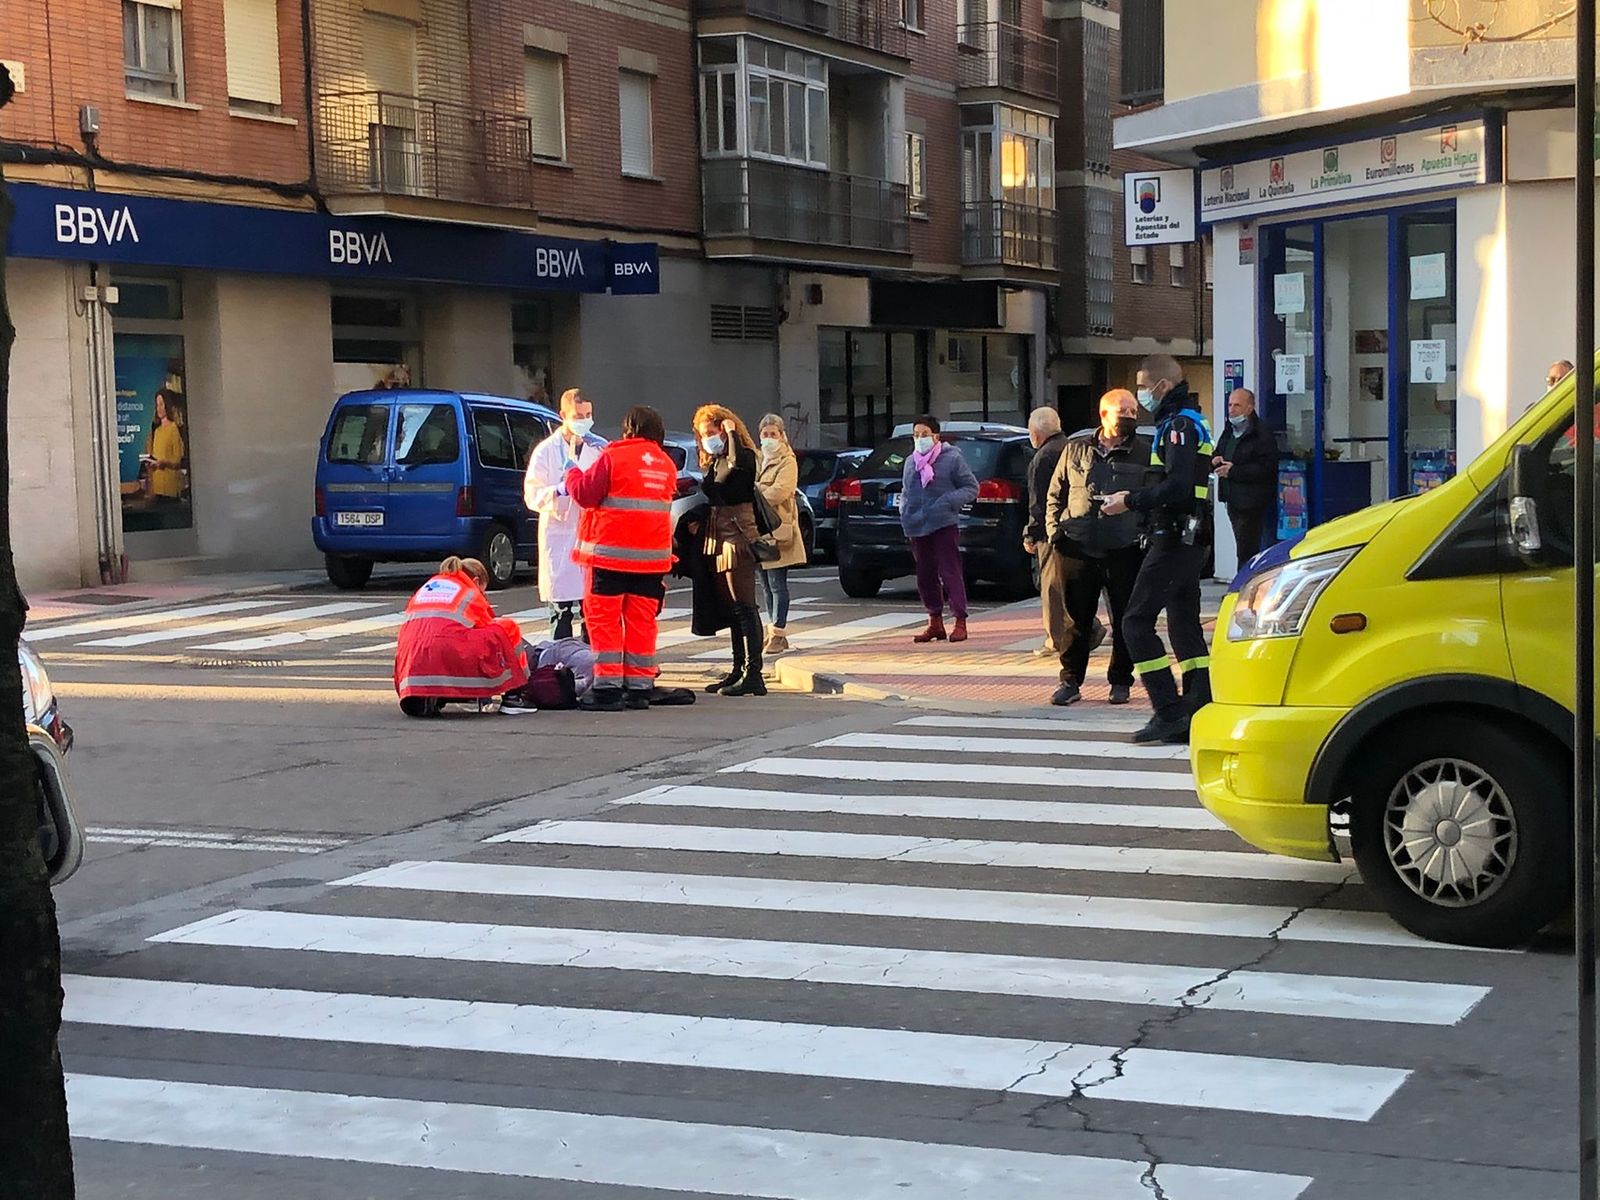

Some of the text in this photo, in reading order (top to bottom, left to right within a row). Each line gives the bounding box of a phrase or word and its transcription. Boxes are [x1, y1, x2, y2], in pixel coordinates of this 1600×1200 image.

[1365, 163, 1414, 179] Euromillones
[1421, 156, 1452, 172] Apuesta
[1310, 172, 1352, 189] La Primitiva
[1225, 187, 1250, 202] Nacional
[1259, 182, 1295, 198] La Quiniela
[55, 204, 139, 245] BBVA
[1135, 221, 1180, 232] Apuestas del
[1135, 231, 1159, 239] Estado
[329, 229, 392, 265] BBVA
[536, 248, 584, 277] BBVA
[614, 261, 652, 275] BBVA
[365, 513, 381, 524] DSP
